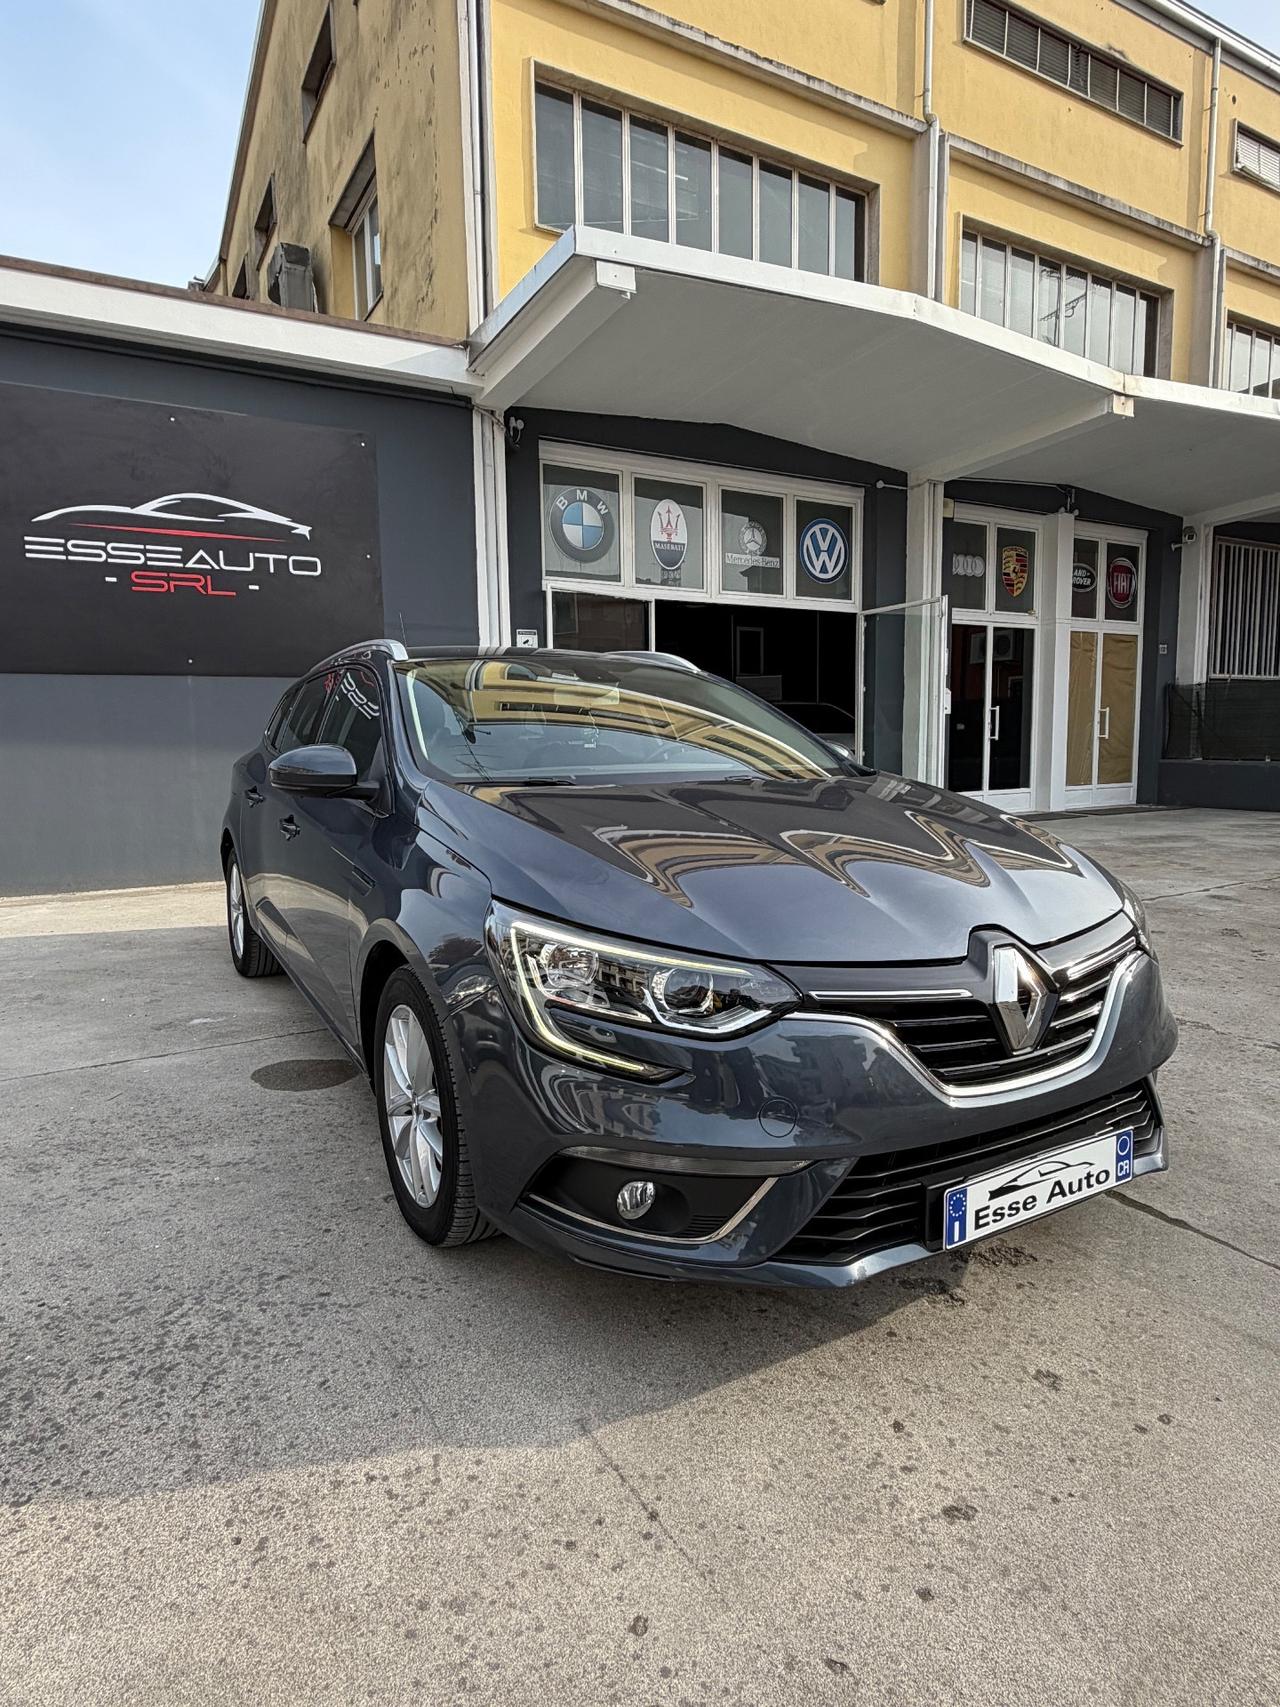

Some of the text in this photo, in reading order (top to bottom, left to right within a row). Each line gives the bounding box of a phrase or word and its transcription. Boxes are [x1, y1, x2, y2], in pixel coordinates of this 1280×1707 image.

[556, 489, 608, 515] BMW
[24, 535, 322, 577] ESSEAUTO
[654, 542, 685, 552] MASERATI
[726, 553, 780, 568] Mercedes-Benz
[130, 570, 237, 596] SRL
[1113, 572, 1131, 594] FIAT
[1117, 1159, 1130, 1177] CR
[974, 1168, 1110, 1230] Esse Auto
